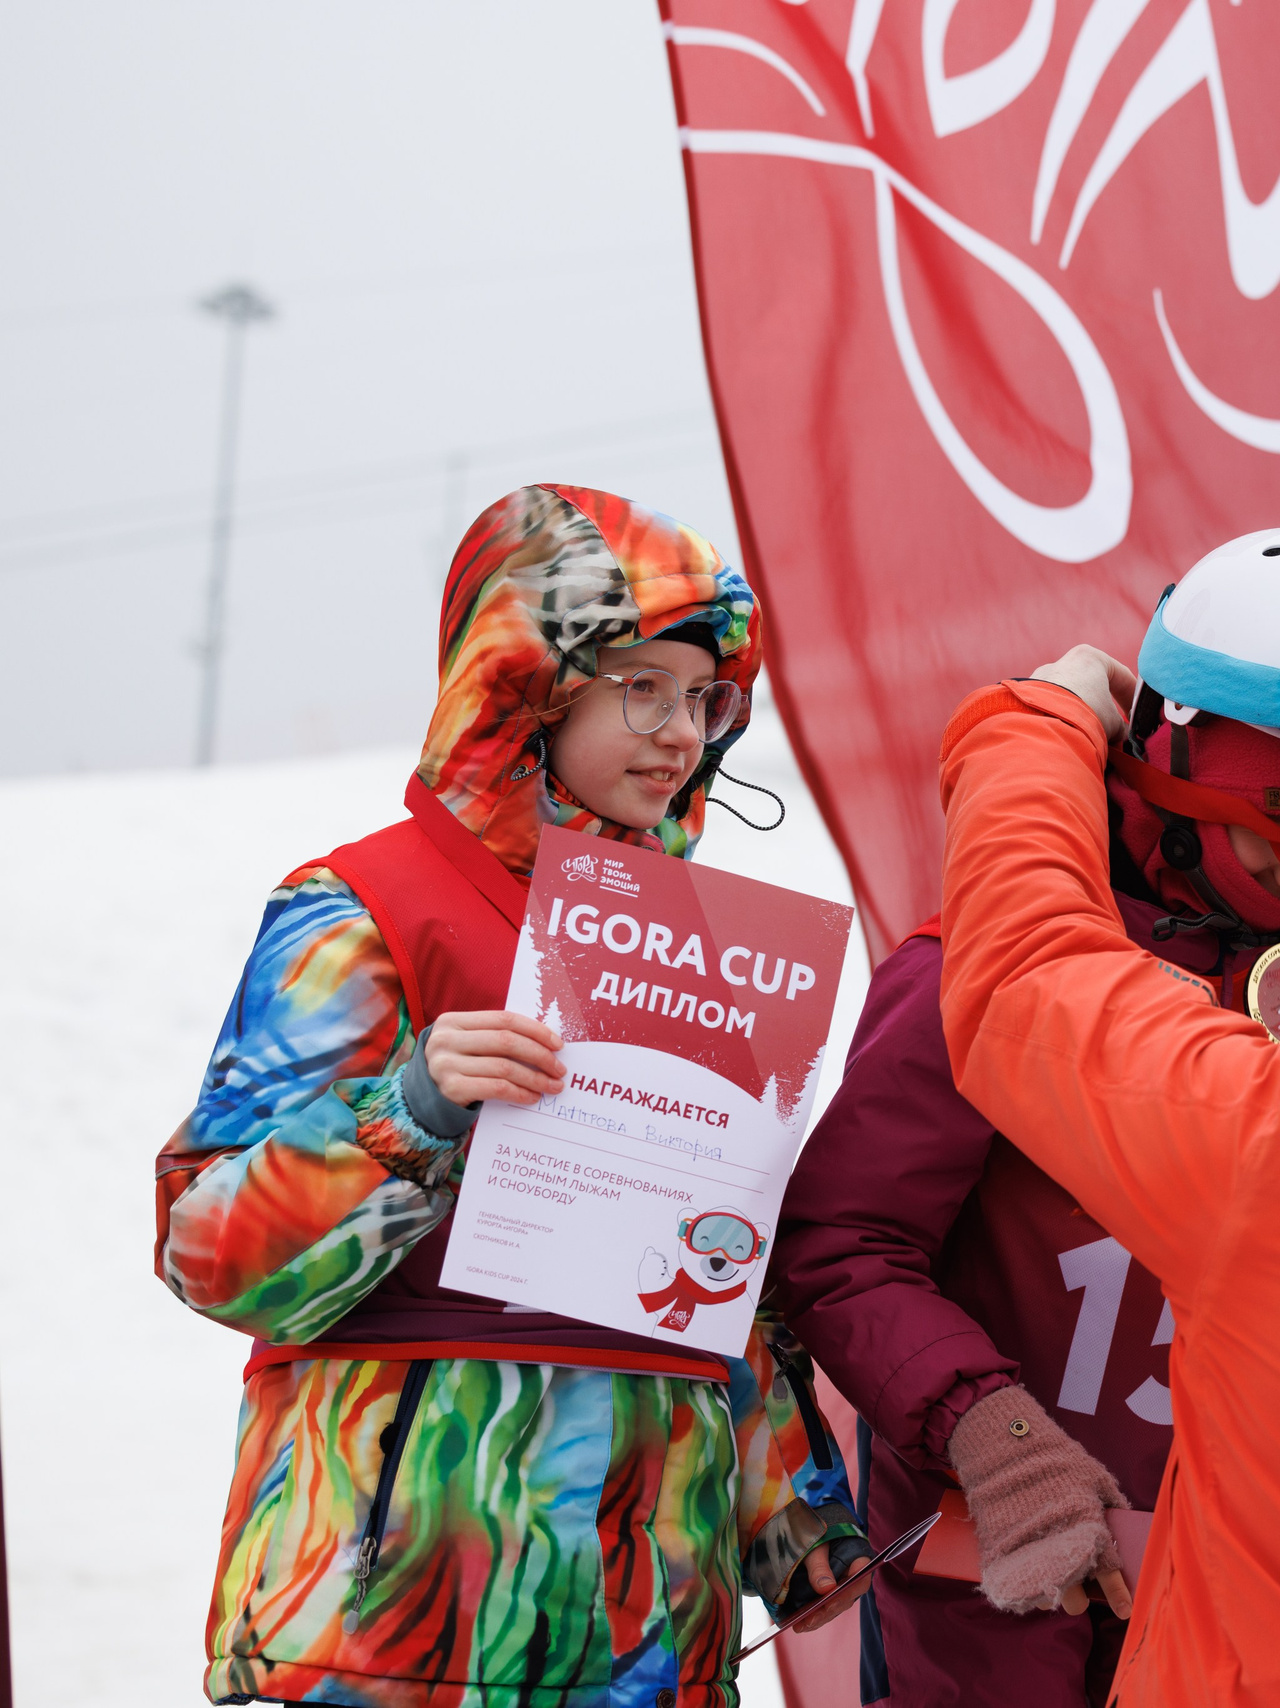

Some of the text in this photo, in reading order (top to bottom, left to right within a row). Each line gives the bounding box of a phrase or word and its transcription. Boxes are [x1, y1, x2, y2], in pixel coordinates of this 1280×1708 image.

[602, 867, 633, 881] ТВОИХ
[603, 858, 625, 869] МИР
[600, 876, 641, 892] ЭМОЦИЙ
[547, 897, 817, 1001] IGORA CUP
[590, 970, 757, 1039] ДИПЛОМ
[569, 1072, 730, 1129] НАГРАЖДАЕТСЯ
[645, 1124, 723, 1162] Виктория
[491, 1159, 621, 1201] ПО ГОРНЫМ ЛЫЖАМ
[495, 1143, 694, 1204] ЗА УЧАСТИЕ В СОРЕВНОВАНИЯХ
[487, 1175, 577, 1205] И СНОУБОРДУ
[477, 1219, 502, 1229] КУРОРТА
[479, 1211, 554, 1233] ГЕНЕРАЛЬНЫЙ ДИРЕКТОР
[473, 1233, 508, 1246] СКОТНИКОВ
[466, 1265, 483, 1275] IGORA
[484, 1270, 497, 1278] KIDS
